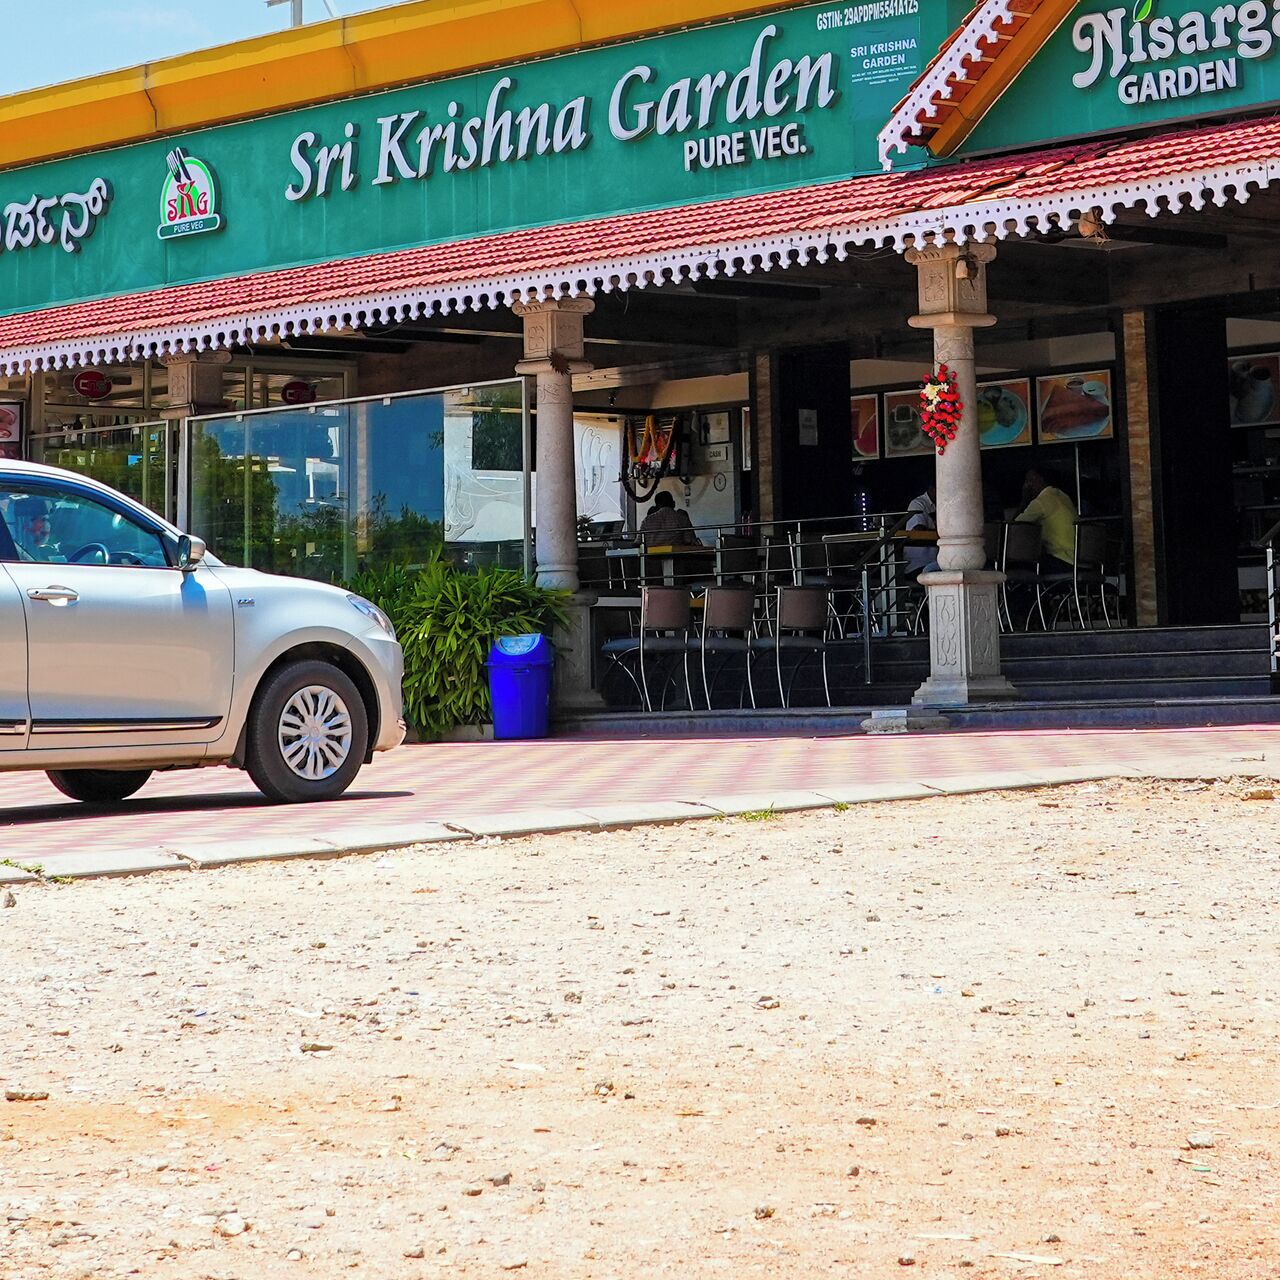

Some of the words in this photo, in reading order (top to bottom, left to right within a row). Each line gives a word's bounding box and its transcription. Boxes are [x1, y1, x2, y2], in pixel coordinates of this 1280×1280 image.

[816, 10, 843, 31] GSTIN:
[850, 46, 867, 58] SRI
[870, 38, 917, 55] KRISHNA
[862, 53, 906, 70] GARDEN
[1118, 57, 1242, 105] GARDEN
[286, 123, 359, 202] Sri
[372, 77, 591, 187] Krishna
[607, 24, 839, 140] Garden
[683, 131, 746, 173] PURE
[749, 126, 808, 161] VEG.
[173, 222, 190, 234] PURE
[191, 220, 204, 231] VEG
